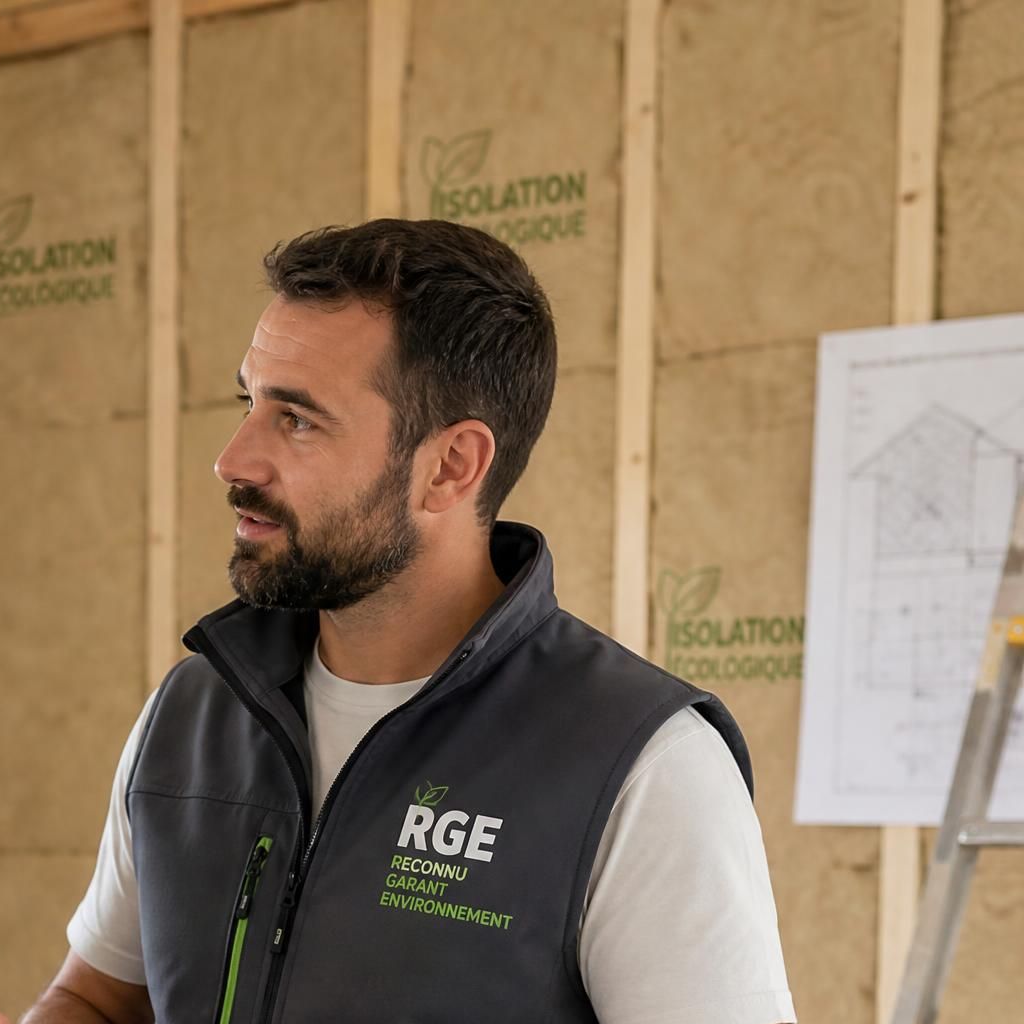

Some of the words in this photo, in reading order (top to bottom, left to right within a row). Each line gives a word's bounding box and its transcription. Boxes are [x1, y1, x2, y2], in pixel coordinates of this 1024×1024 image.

[440, 170, 587, 219] ISOLATION
[482, 208, 586, 245] OGIQUE
[671, 615, 805, 647] ISOLATION
[396, 803, 504, 863] RGE
[385, 873, 449, 897] GARANT
[390, 854, 469, 882] RECONNU
[379, 891, 514, 931] ENVIRONNEMENT
